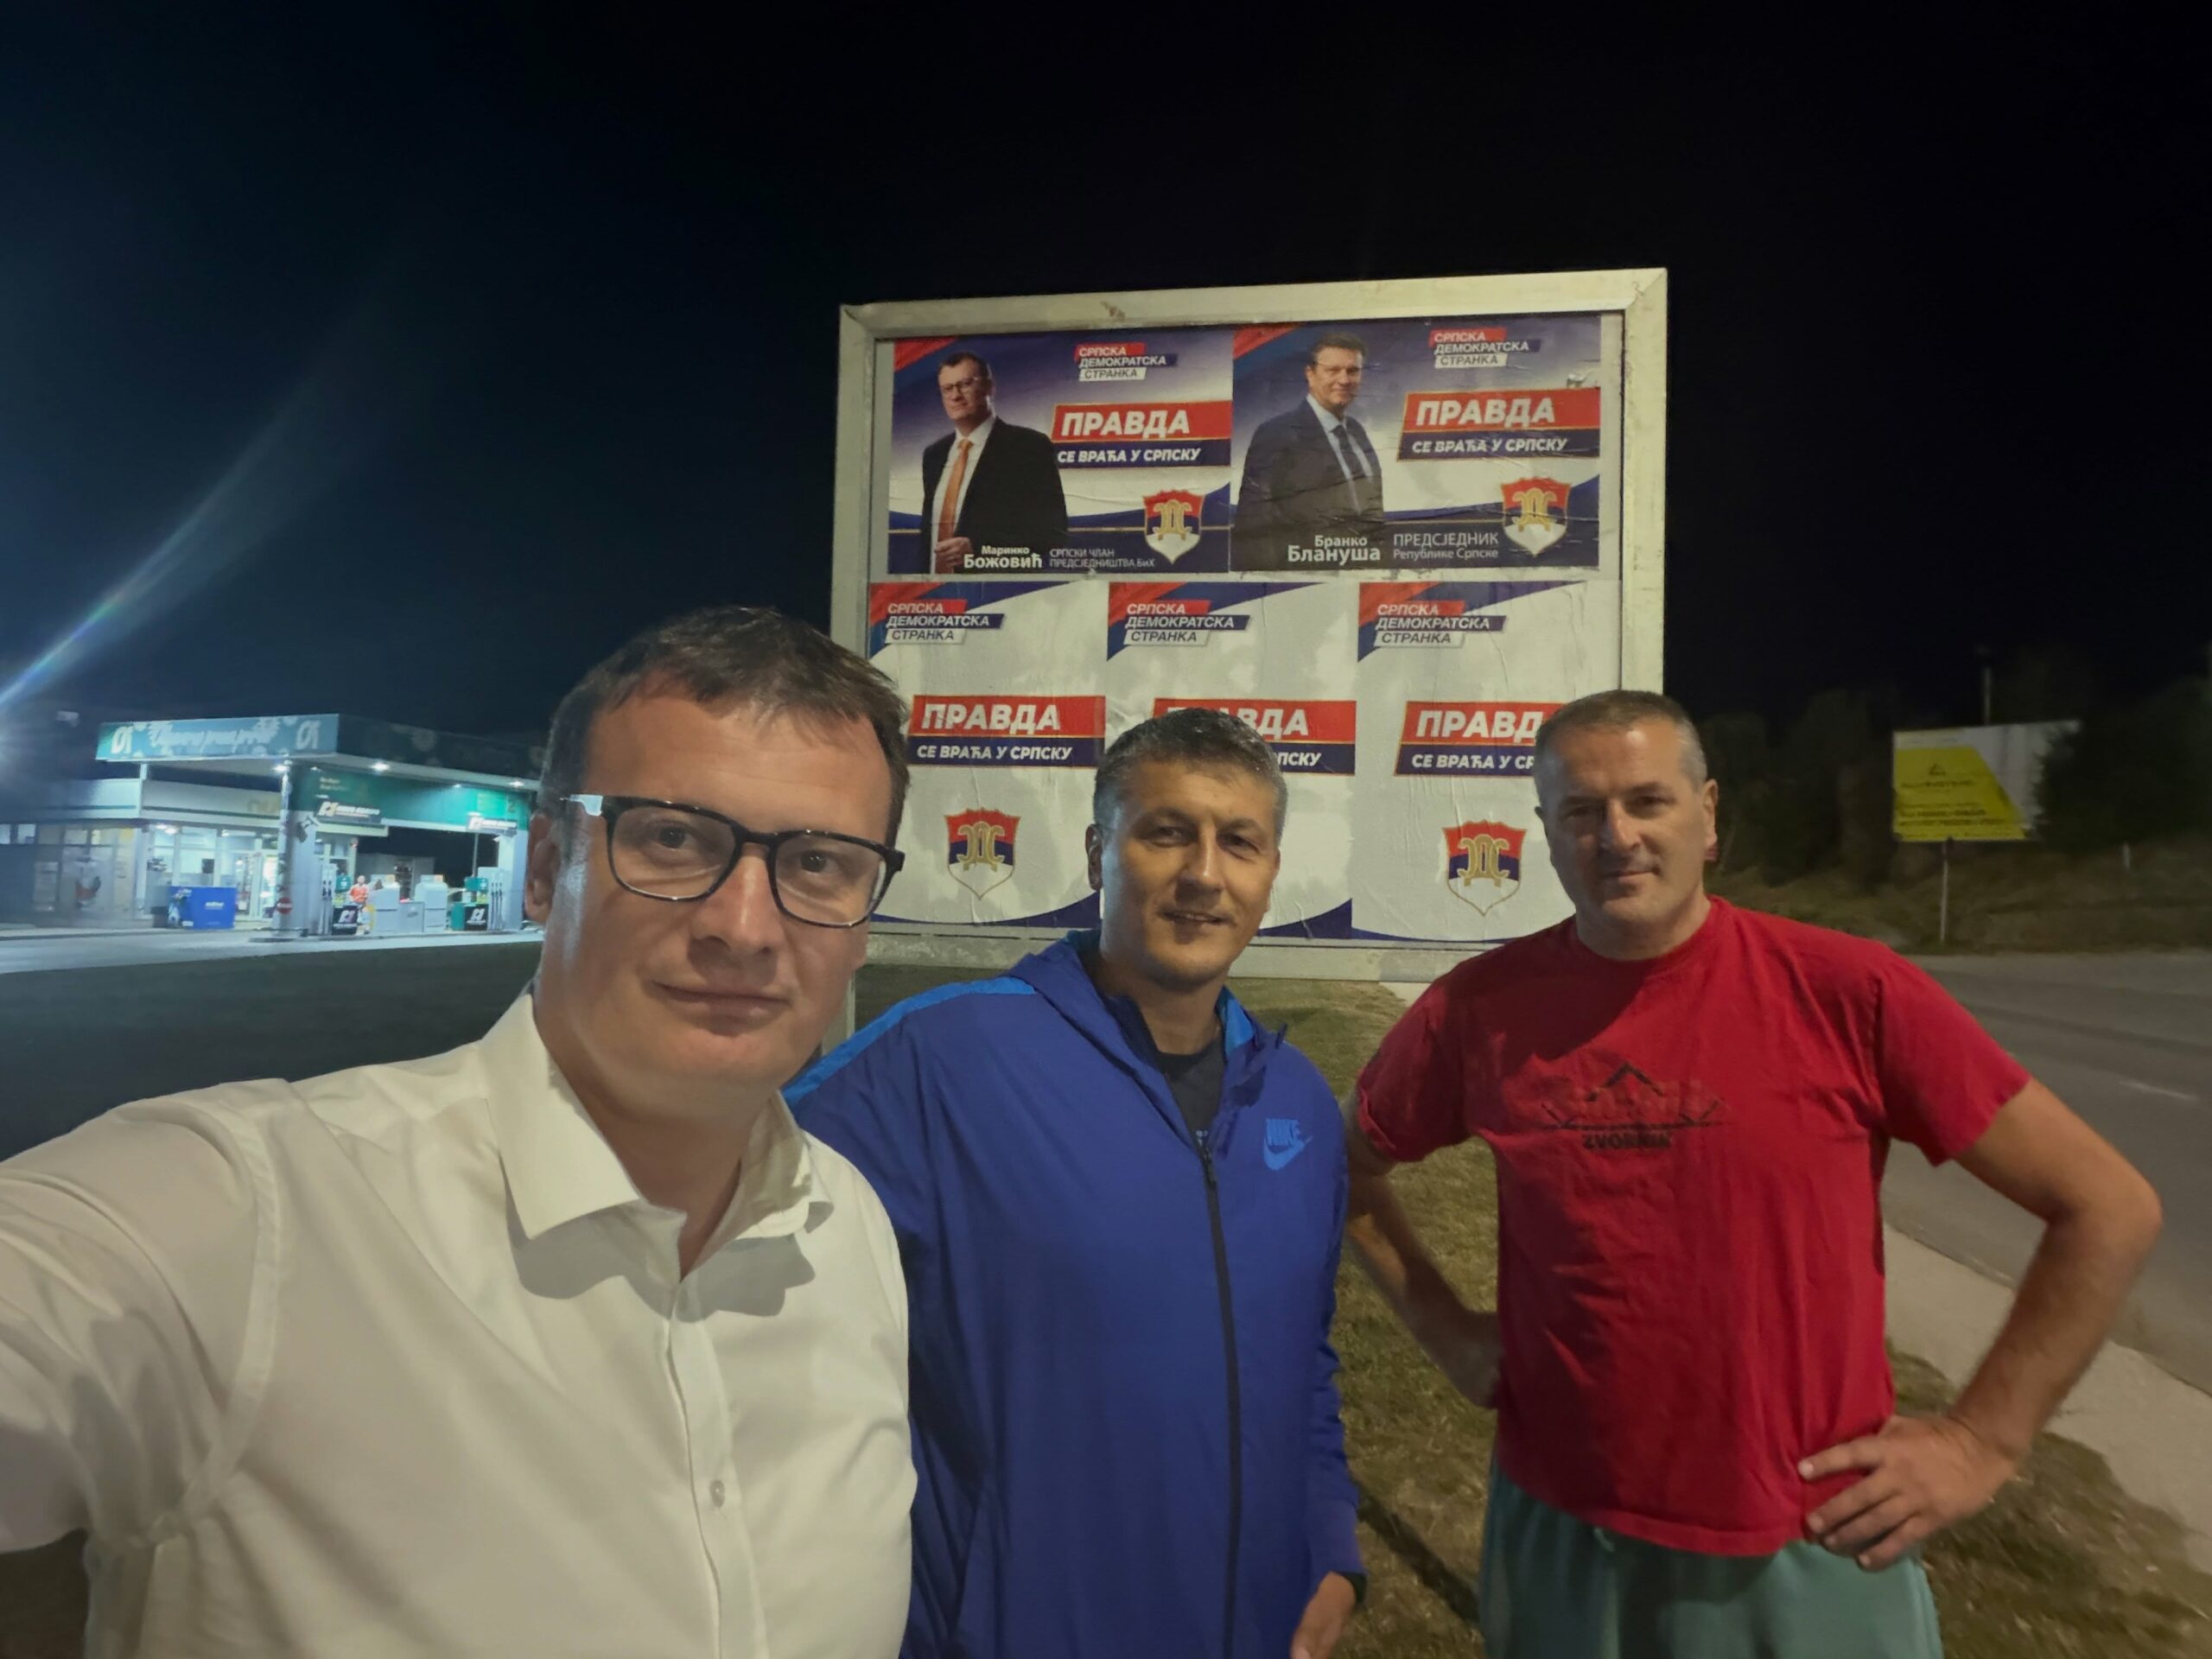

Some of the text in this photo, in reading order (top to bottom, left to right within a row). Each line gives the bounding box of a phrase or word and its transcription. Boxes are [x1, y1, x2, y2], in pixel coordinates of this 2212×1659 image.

[1434, 332, 1486, 342] СРПСКА
[1079, 346, 1127, 358] СРПСКА
[1434, 340, 1529, 355] ДЕМОКРАТСКА
[1079, 356, 1166, 369] ДЕМОКРАТСКА
[1440, 353, 1498, 366] СТРАНКА
[1084, 369, 1138, 379] СТРАНКА
[1415, 397, 1555, 429] ПРАВДА
[1061, 410, 1191, 441] ПРАВДА
[1412, 437, 1568, 454] СЕ ВРАЋА У СРПСКУ
[1057, 447, 1202, 463] СЕ ВРАЋА У СРПСКУ
[1314, 535, 1368, 549] Бранко
[1393, 532, 1499, 548] ПРЕДСЈЕДНИК
[982, 545, 1030, 556] Маринко
[1287, 544, 1381, 566] Блануша
[1393, 547, 1499, 562] Републике Српске
[963, 552, 1042, 569] Божовић
[887, 602, 944, 614] СРПСКА
[1126, 603, 1186, 615] СРПСКА
[1376, 604, 1440, 616] СРПСКА
[885, 615, 990, 628] ДЕМОКРАТСКА
[1124, 615, 1236, 629] ДЕМОКРАТСКА
[1375, 617, 1491, 631] ДЕМОКРАТСКА
[892, 629, 955, 641] СТРАНКА
[1130, 630, 1198, 643] СТРАНКА
[1381, 632, 1452, 645] СТРАНКА
[921, 702, 1061, 735] ПРАВДА
[1415, 709, 1543, 744] ПРАВД
[917, 745, 1073, 761] СЕ ВРАЋА У СРПСКУ
[1275, 751, 1322, 766] ПСКУ
[1411, 753, 1433, 768] СЕ
[1435, 754, 1495, 770] ВРАЋА
[1498, 754, 1512, 769] У
